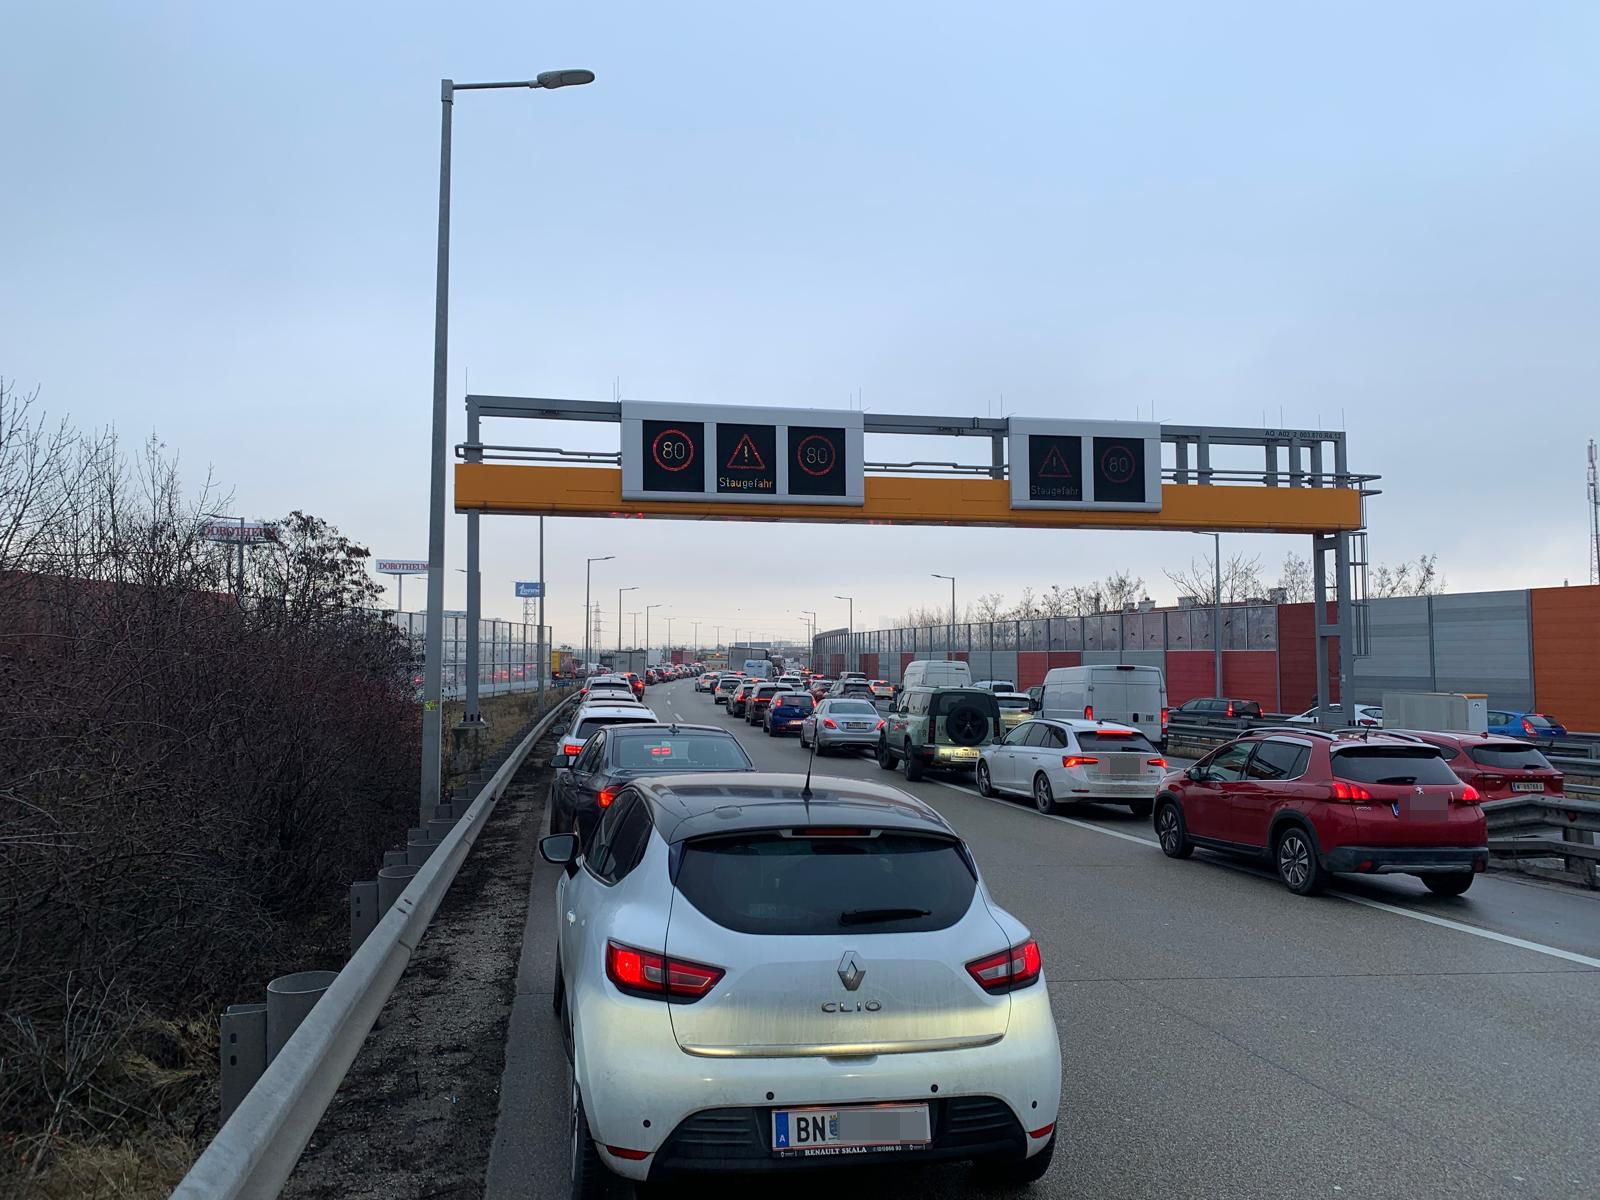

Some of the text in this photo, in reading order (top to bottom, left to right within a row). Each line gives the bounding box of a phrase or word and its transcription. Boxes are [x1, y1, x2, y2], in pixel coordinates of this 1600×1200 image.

[662, 441, 685, 459] 80
[806, 447, 828, 464] 80
[1108, 456, 1129, 473] 80
[719, 477, 773, 489] Staugefahr
[1030, 485, 1079, 497] Staugefahr
[821, 1000, 882, 1013] CLIO
[796, 1115, 826, 1143] BN
[779, 1134, 787, 1143] A
[804, 1148, 841, 1157] RENAULT
[841, 1146, 868, 1155] SKALA
